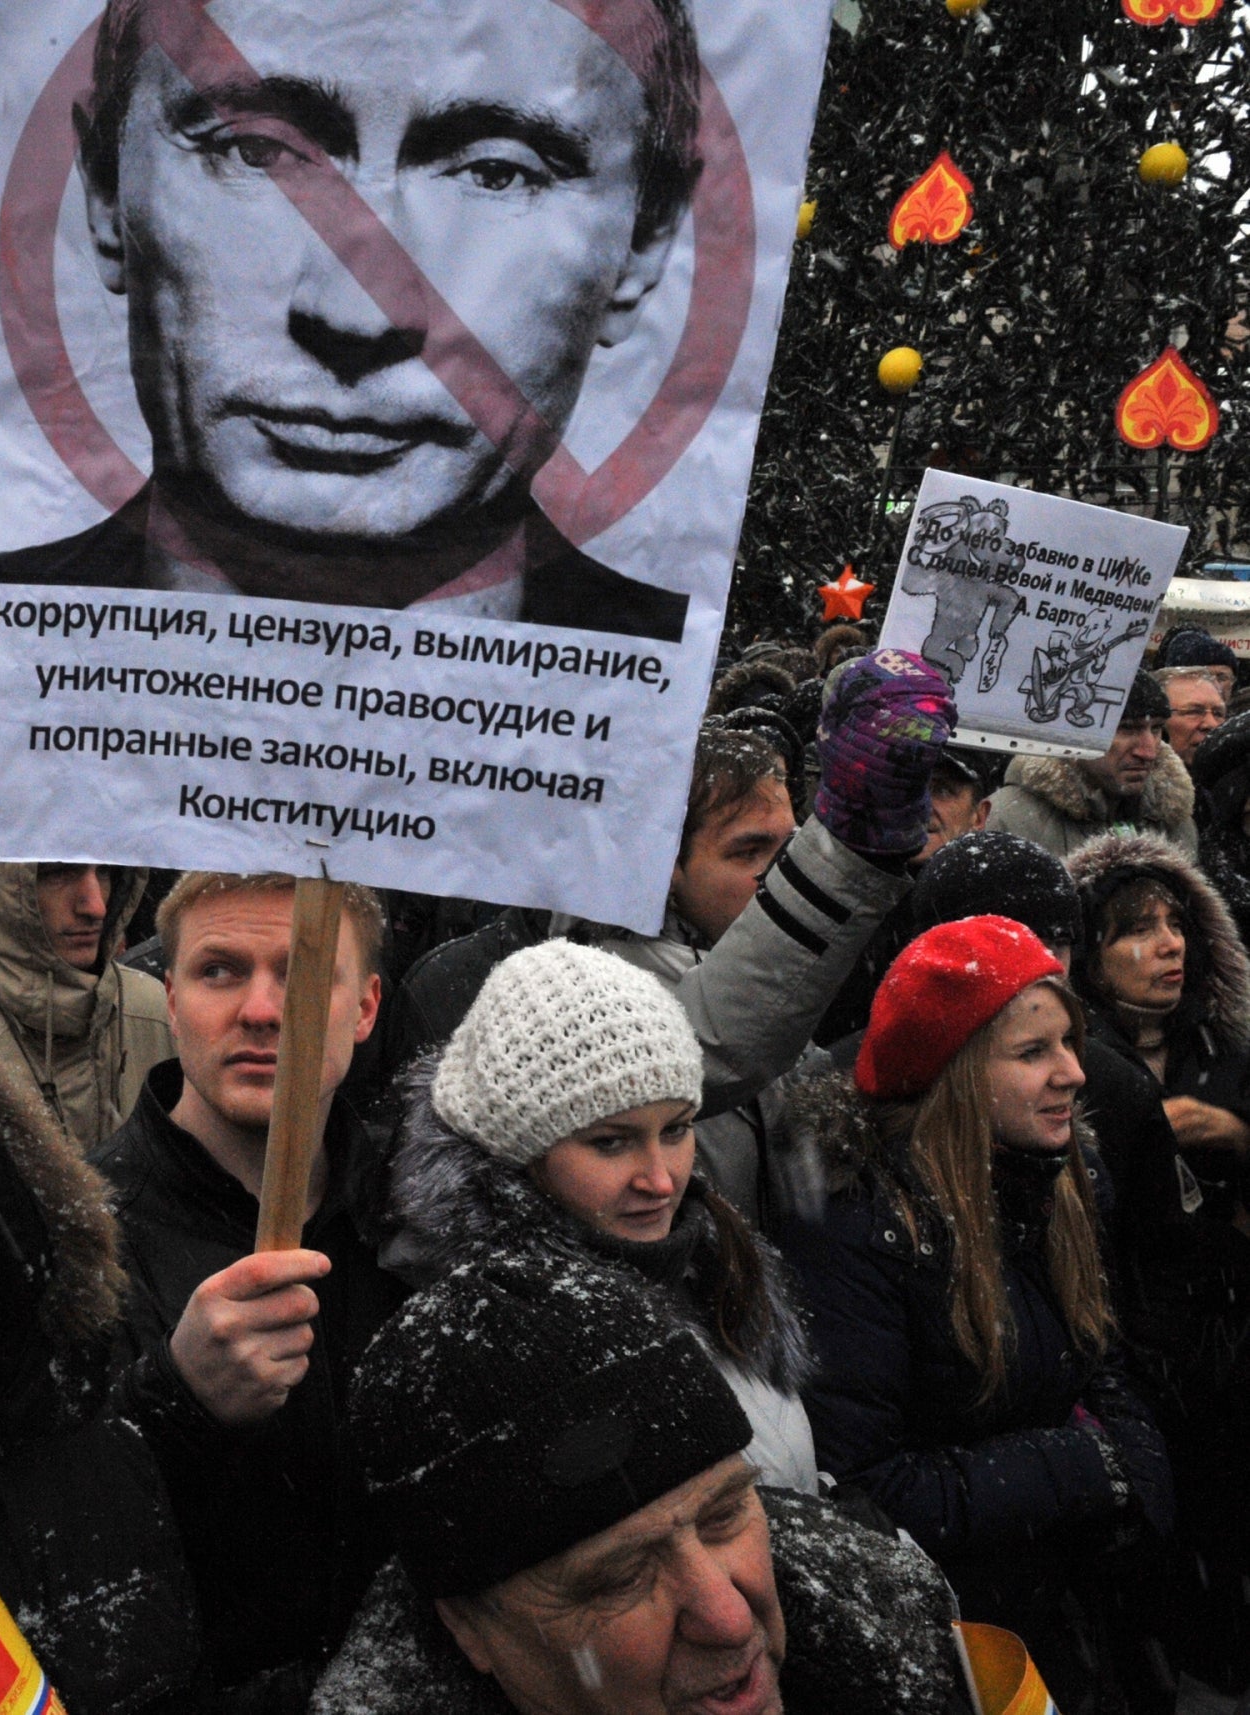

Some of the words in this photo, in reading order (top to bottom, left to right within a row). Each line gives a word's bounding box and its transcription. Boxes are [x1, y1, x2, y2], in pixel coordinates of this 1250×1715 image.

[959, 530, 1002, 553] чего
[1004, 537, 1079, 570] забавно
[1082, 557, 1094, 573] в
[994, 563, 1053, 592] Вовой
[1055, 580, 1067, 595] и
[1012, 595, 1030, 617] А.
[1036, 600, 1086, 628] Барто
[228, 612, 402, 660] цензура,
[413, 629, 671, 693] вымирание,
[35, 665, 323, 707] уничтоженное
[335, 684, 575, 738] правосудие
[584, 714, 611, 741] и
[29, 725, 251, 760] попранные
[260, 739, 416, 785] законы,
[428, 756, 605, 803] включая
[179, 784, 436, 841] Конституцию
